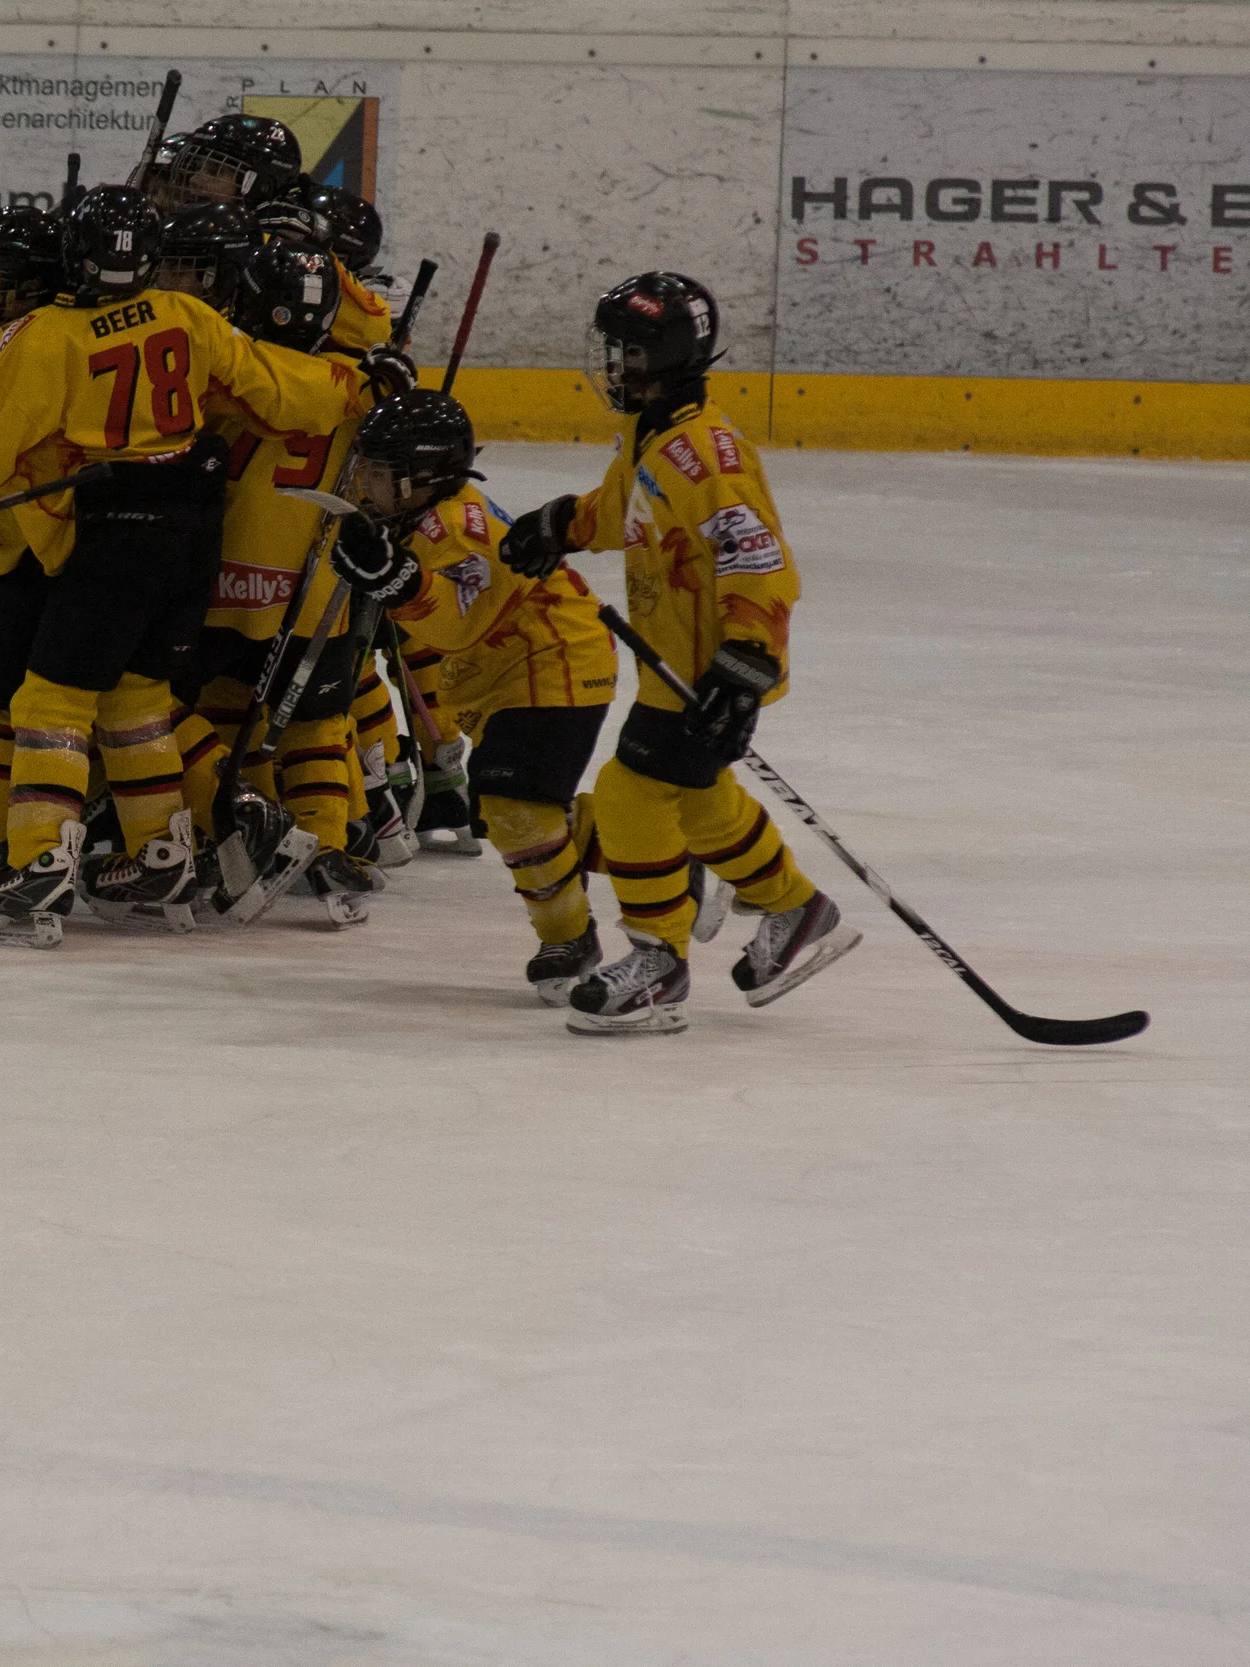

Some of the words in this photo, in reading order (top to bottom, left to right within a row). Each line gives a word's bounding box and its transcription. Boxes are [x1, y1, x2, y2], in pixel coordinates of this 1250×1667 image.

[241, 78, 367, 95] PLAN
[791, 175, 1103, 226] HAGER
[1126, 182, 1188, 227] &
[114, 230, 132, 252] 78
[795, 237, 1234, 274] STRAHLTE
[90, 300, 157, 339] BEER
[88, 327, 196, 450] 78
[667, 437, 703, 477] Kelly's
[217, 573, 291, 603] Kelly's
